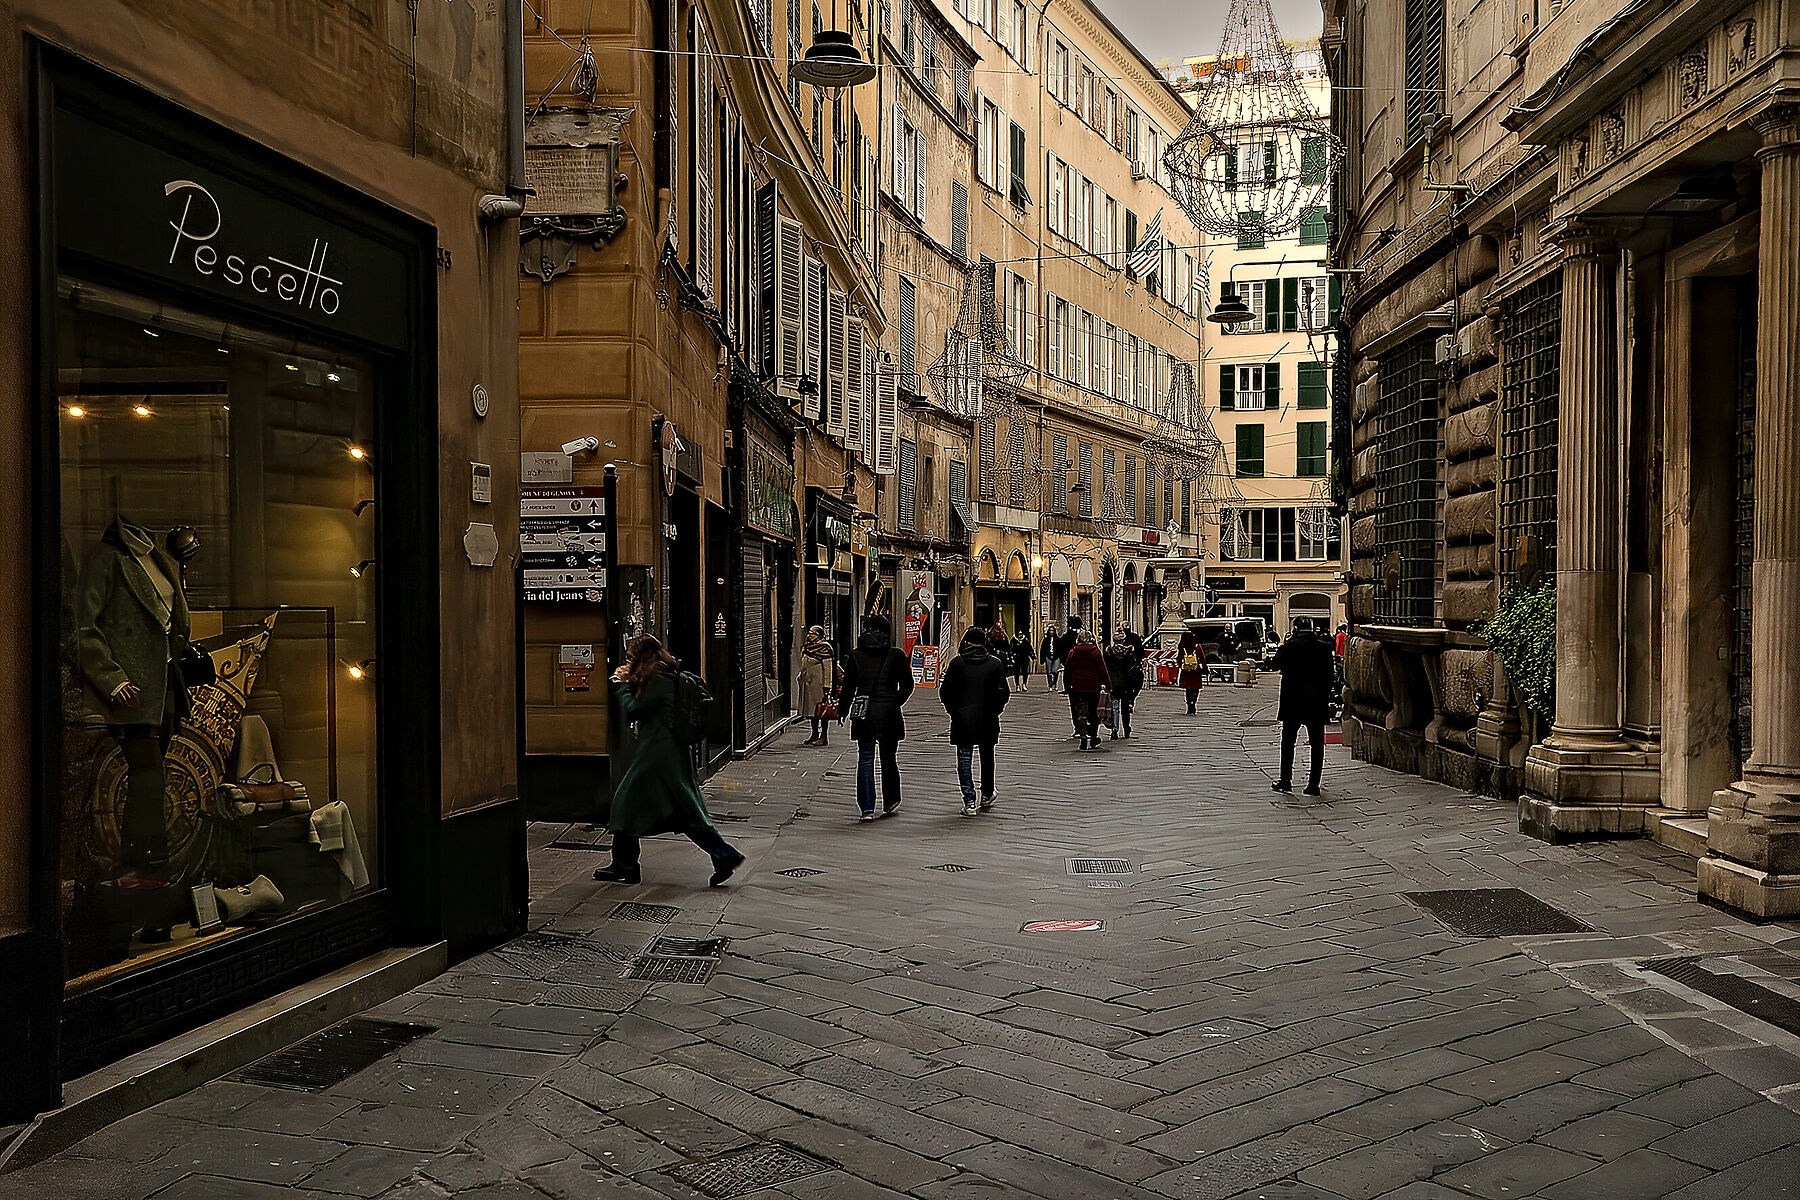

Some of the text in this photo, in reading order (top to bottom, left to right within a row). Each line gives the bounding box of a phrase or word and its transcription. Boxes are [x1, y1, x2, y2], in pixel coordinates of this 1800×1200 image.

[164, 179, 344, 315] Pescetto
[538, 590, 554, 601] del
[556, 590, 584, 602] Jeans
